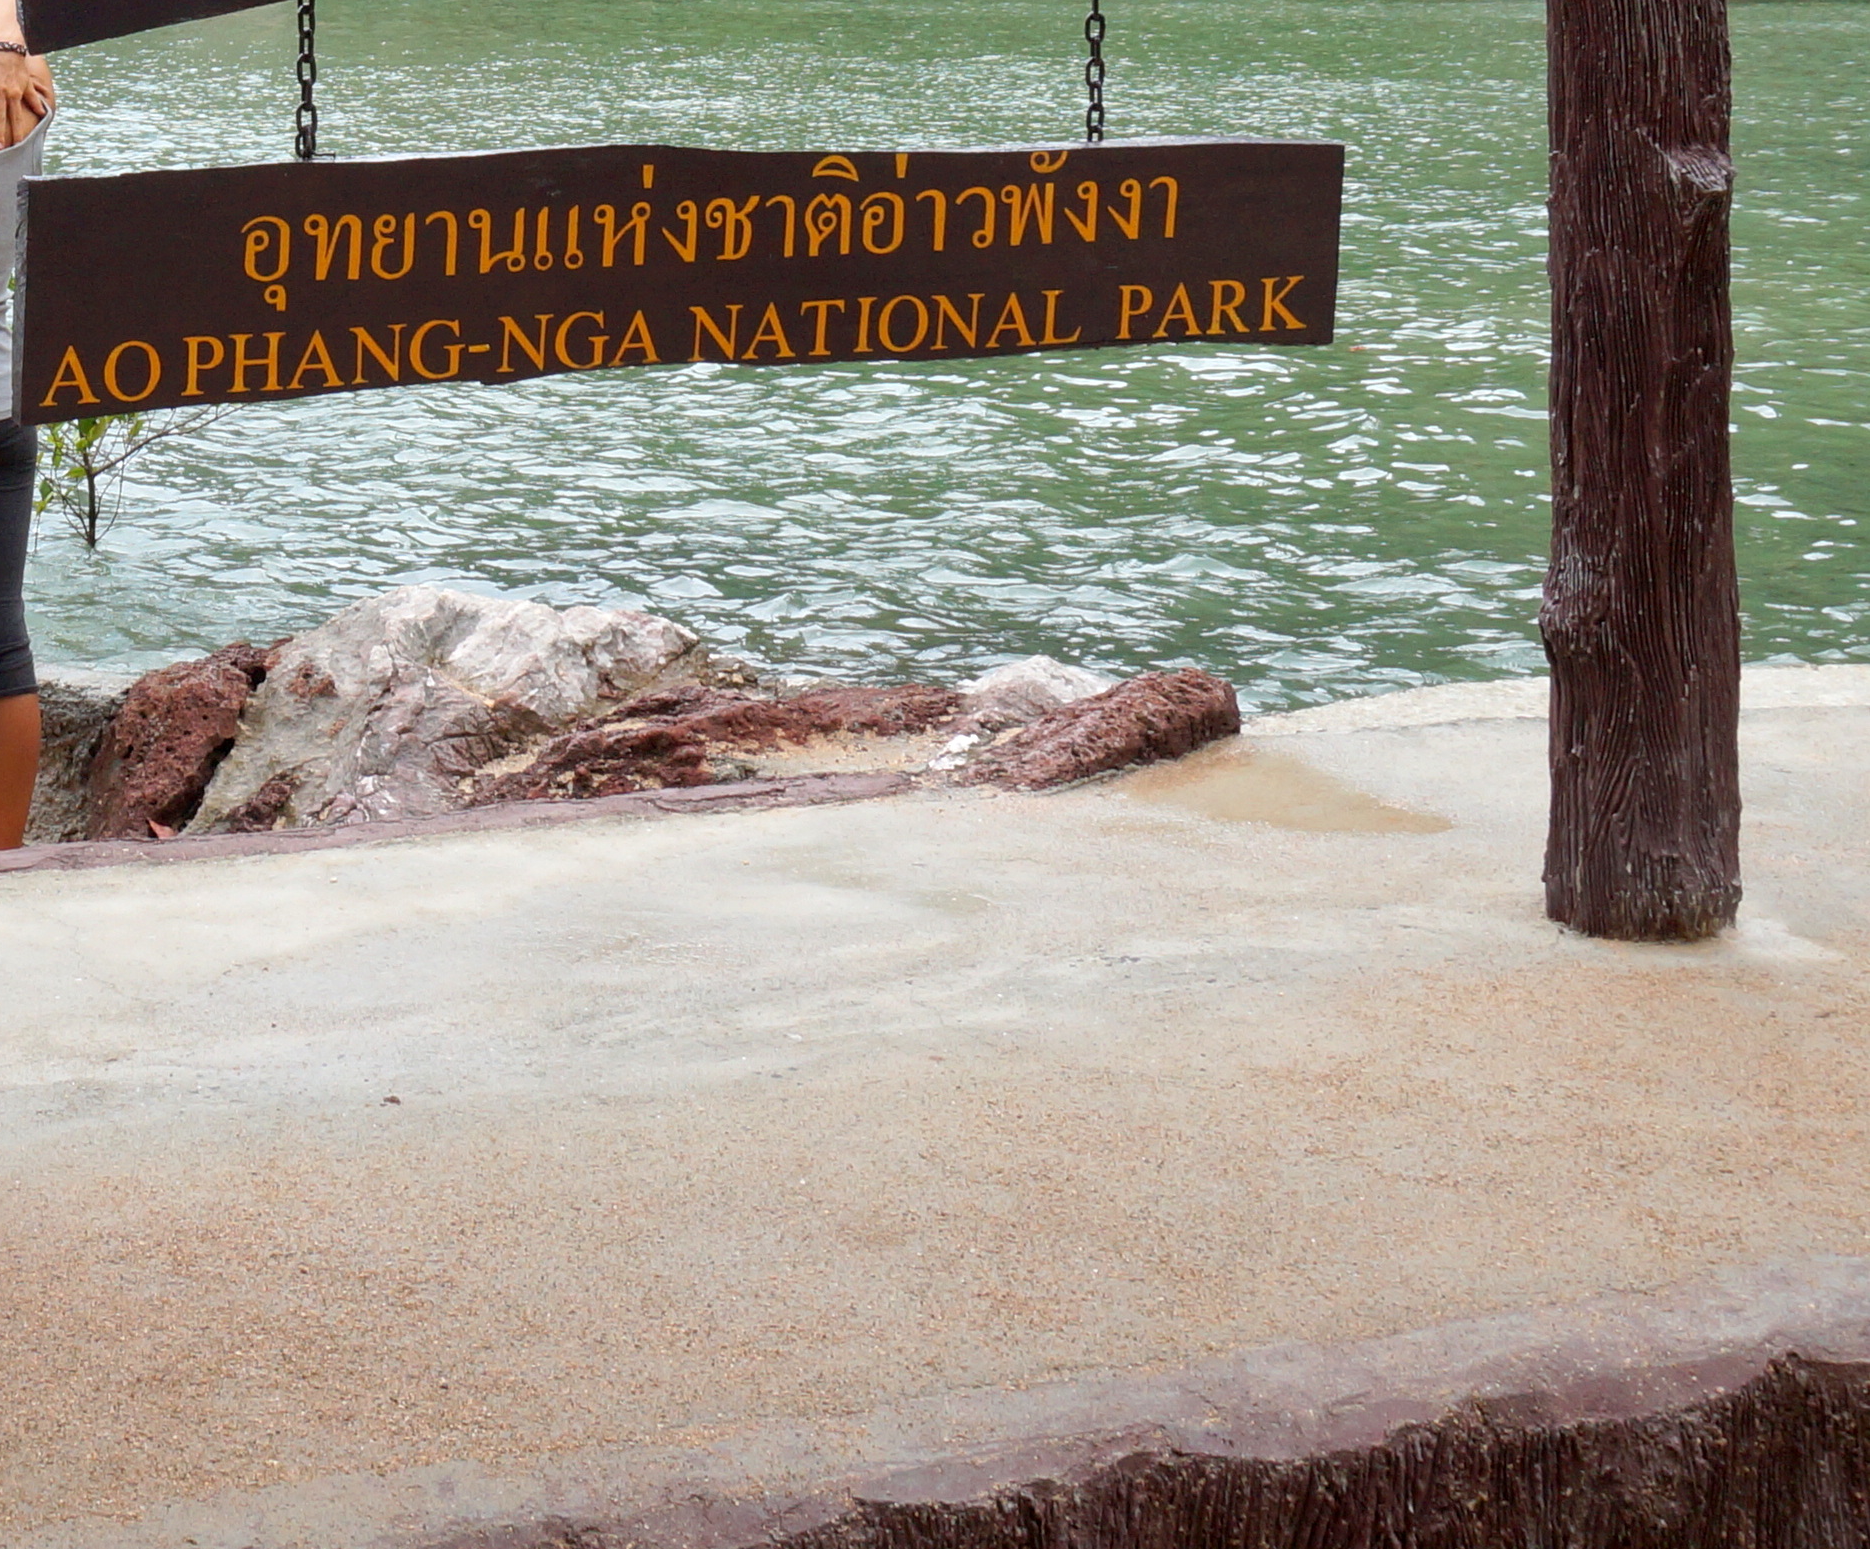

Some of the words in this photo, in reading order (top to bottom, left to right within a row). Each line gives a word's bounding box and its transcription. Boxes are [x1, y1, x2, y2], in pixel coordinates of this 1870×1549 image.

[240, 151, 1179, 313] อุทยานแห่งชาติอ่าวพังงา
[40, 340, 162, 408] AO
[181, 310, 661, 397] PHANG-NGA
[689, 288, 1082, 363] NATIONAL
[1115, 275, 1308, 340] PARK
